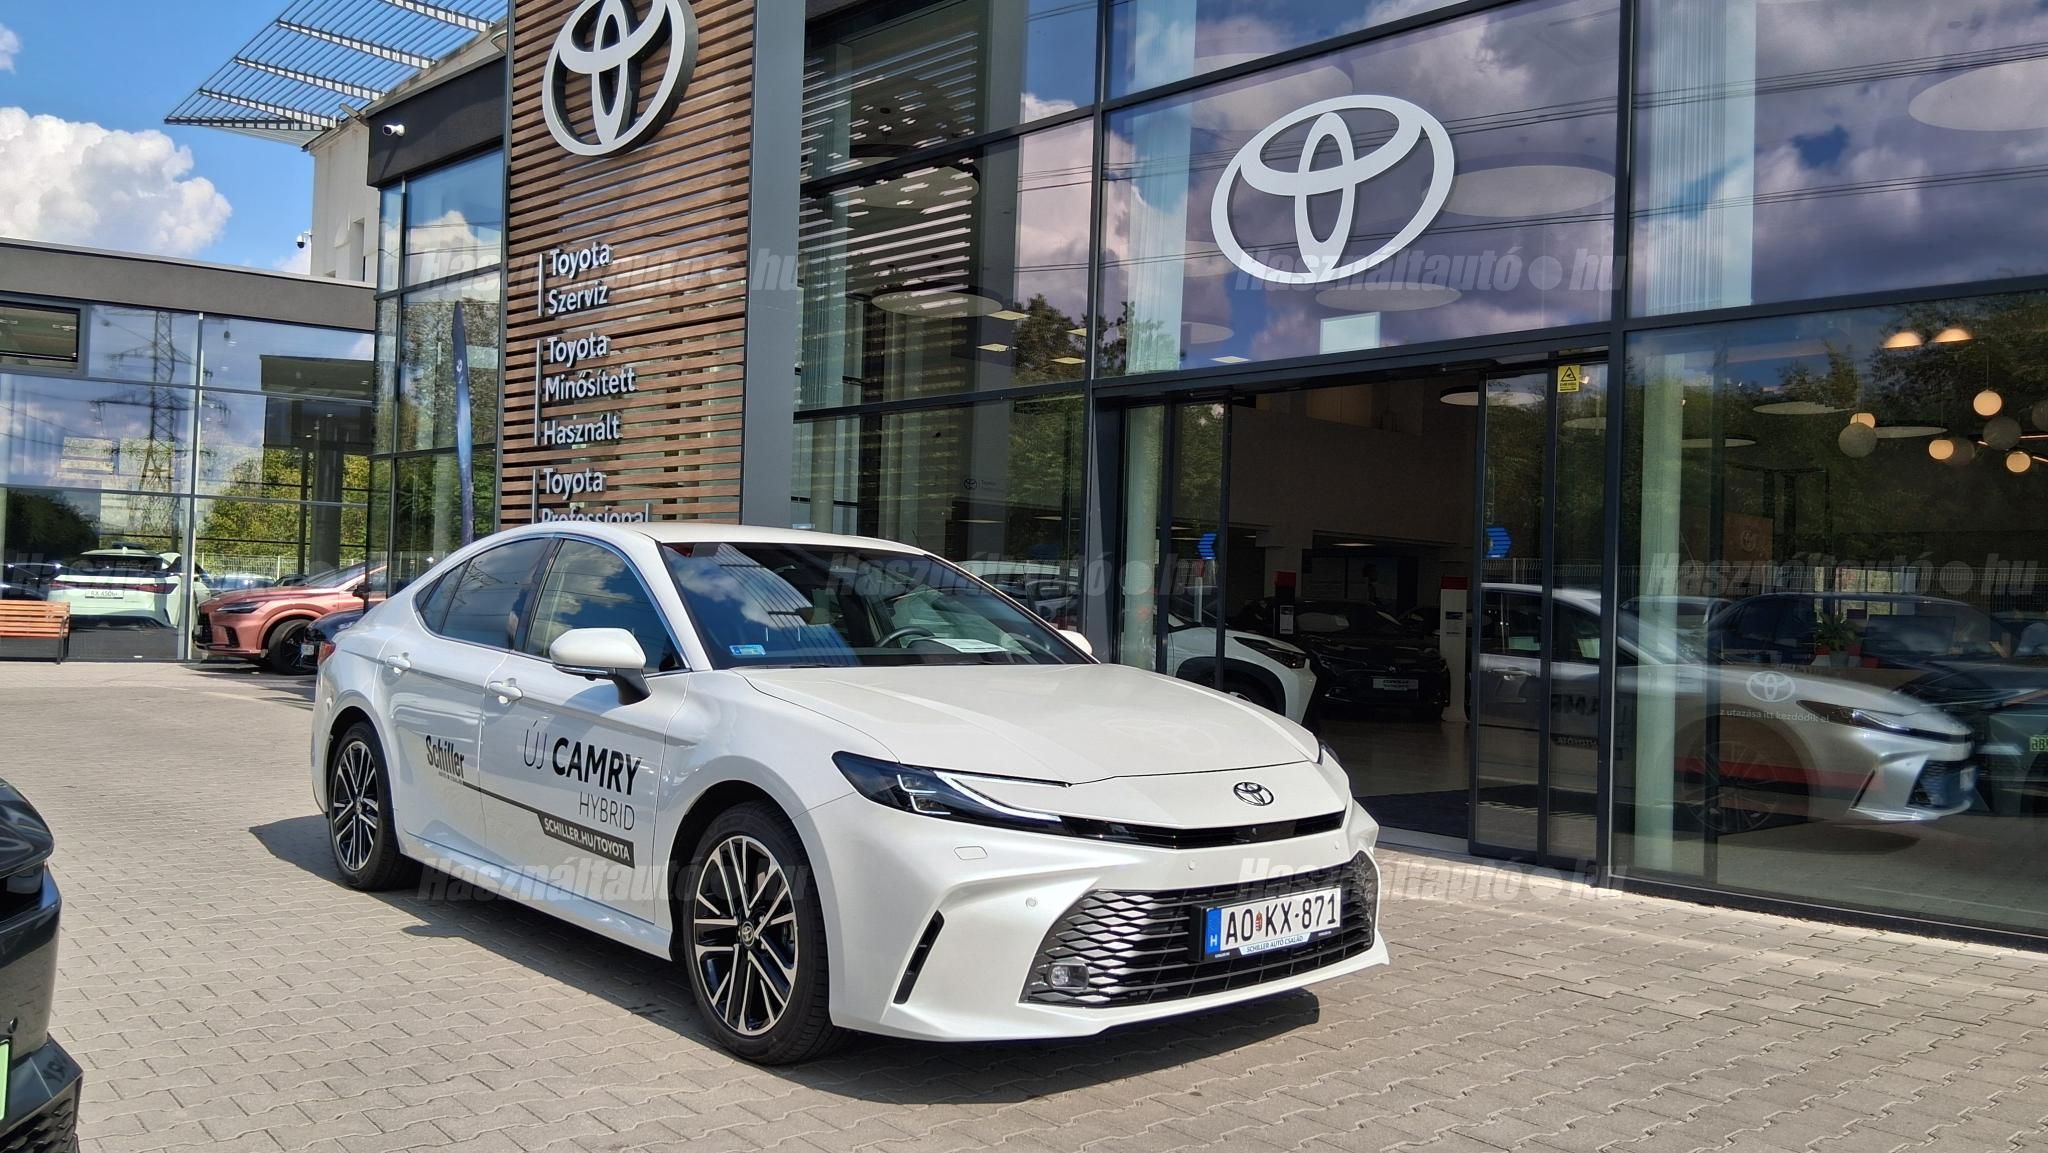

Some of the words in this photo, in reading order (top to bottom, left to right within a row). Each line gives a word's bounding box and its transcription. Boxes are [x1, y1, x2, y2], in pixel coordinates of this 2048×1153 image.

[550, 242, 610, 279] Toyota
[548, 281, 608, 314] Szerviz
[547, 332, 608, 367] Toyota
[545, 367, 635, 401] Minősített
[544, 412, 620, 444] Használt
[544, 467, 604, 500] Toyota
[426, 735, 464, 779] Schiller
[523, 720, 547, 769] ÚJ
[552, 737, 642, 795] CAMRY
[579, 791, 635, 831] HYBRID
[544, 817, 630, 861] SCHILLER.HU/TOYOTA
[1209, 934, 1218, 947] H
[1246, 941, 1270, 953] SCHILLER
